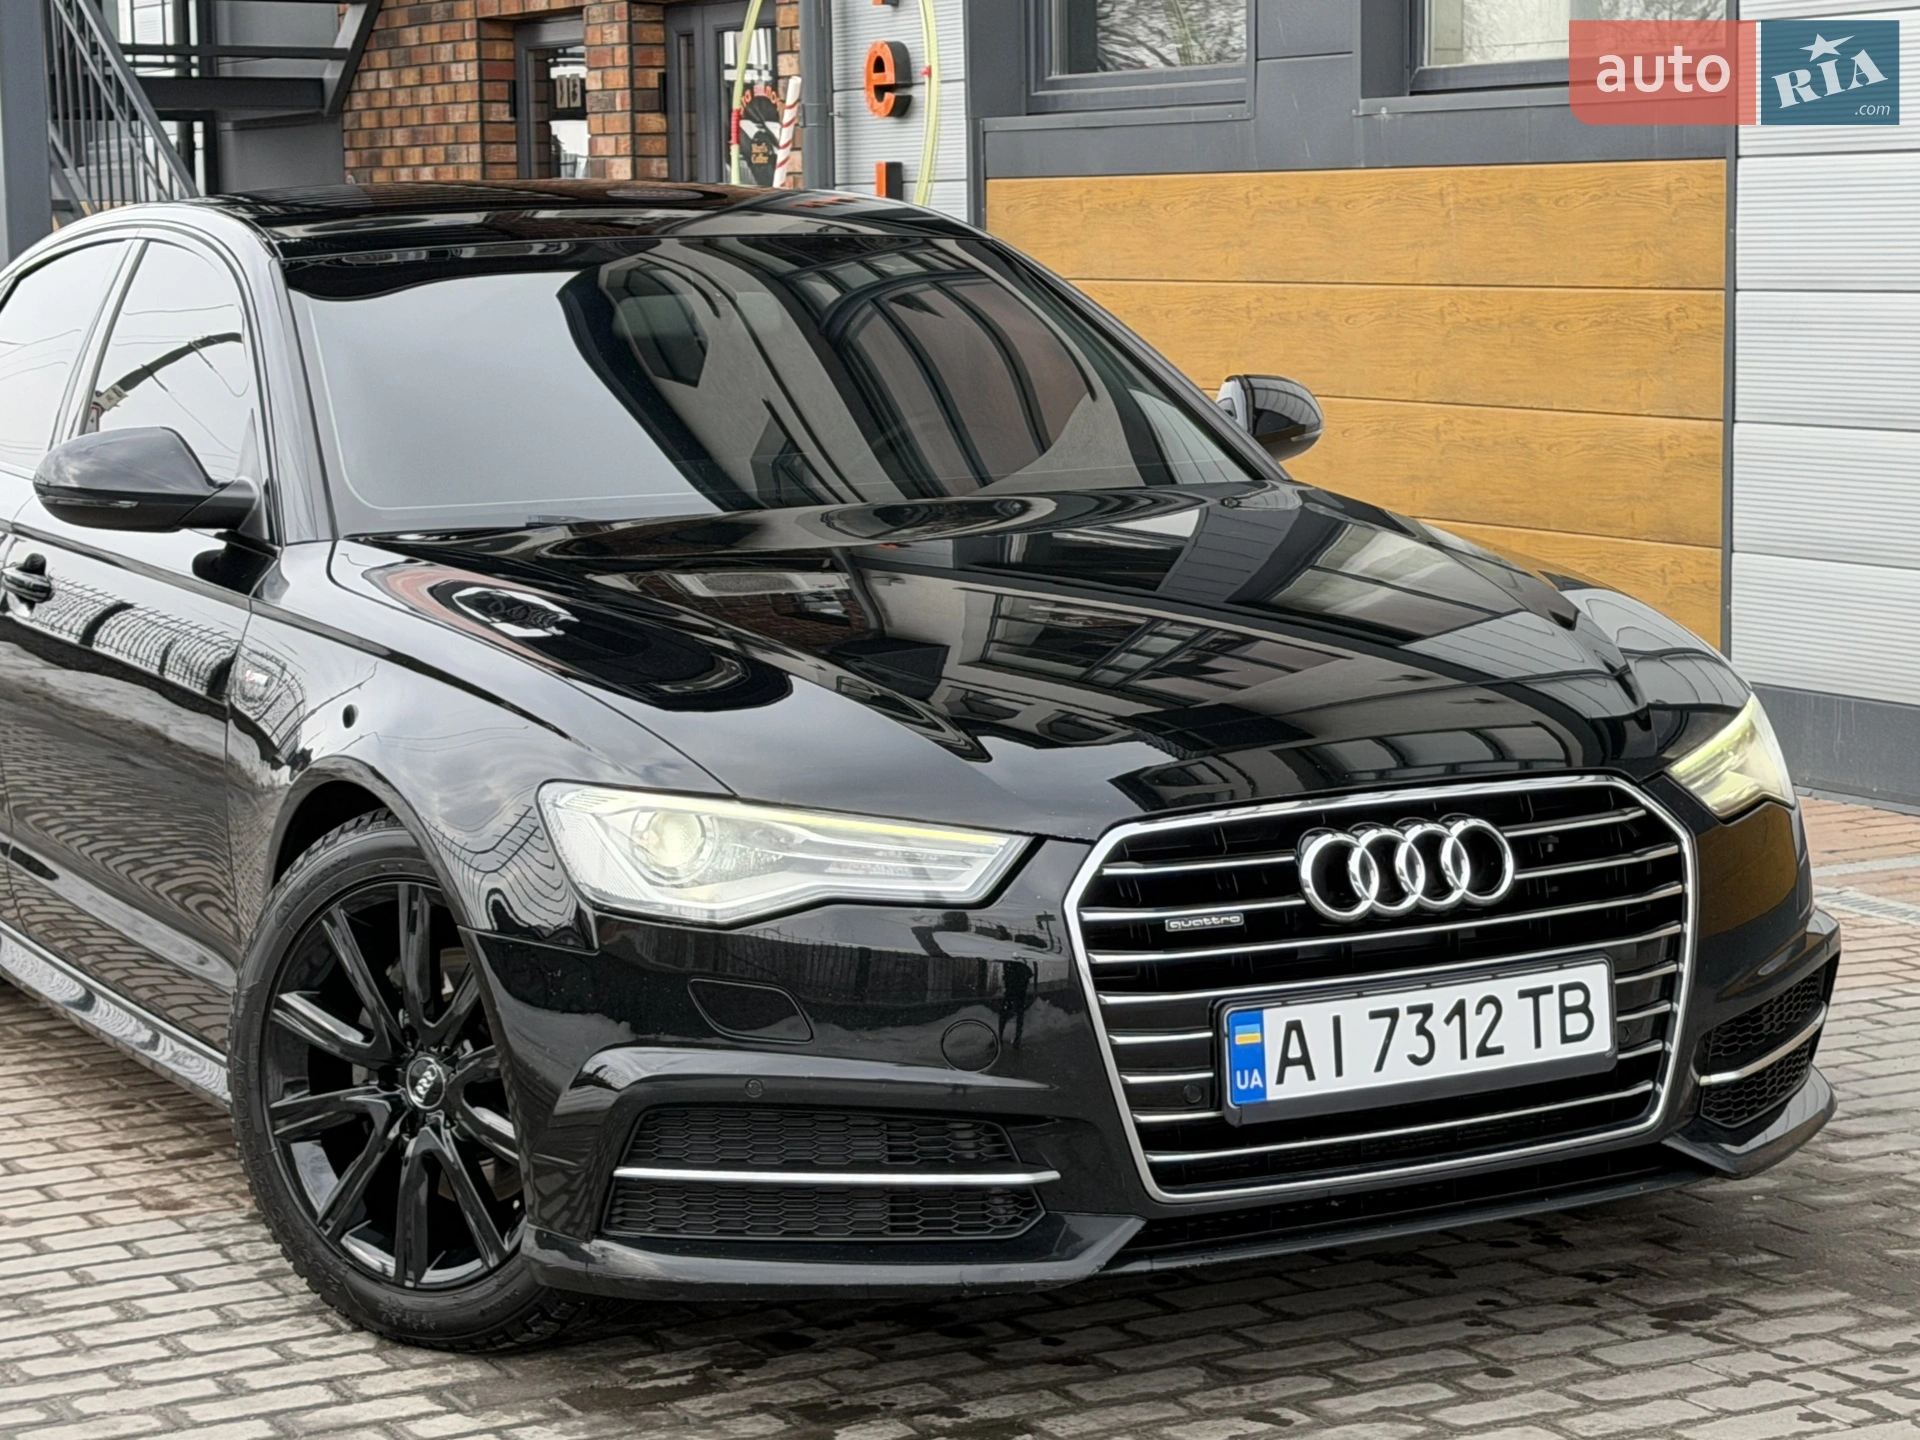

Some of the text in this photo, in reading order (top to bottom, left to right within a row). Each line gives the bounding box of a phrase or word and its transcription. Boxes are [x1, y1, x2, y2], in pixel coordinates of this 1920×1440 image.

[1169, 915, 1241, 930] quattro
[1275, 981, 1595, 1085] AI 7312 TB
[1235, 1068, 1263, 1091] UA
